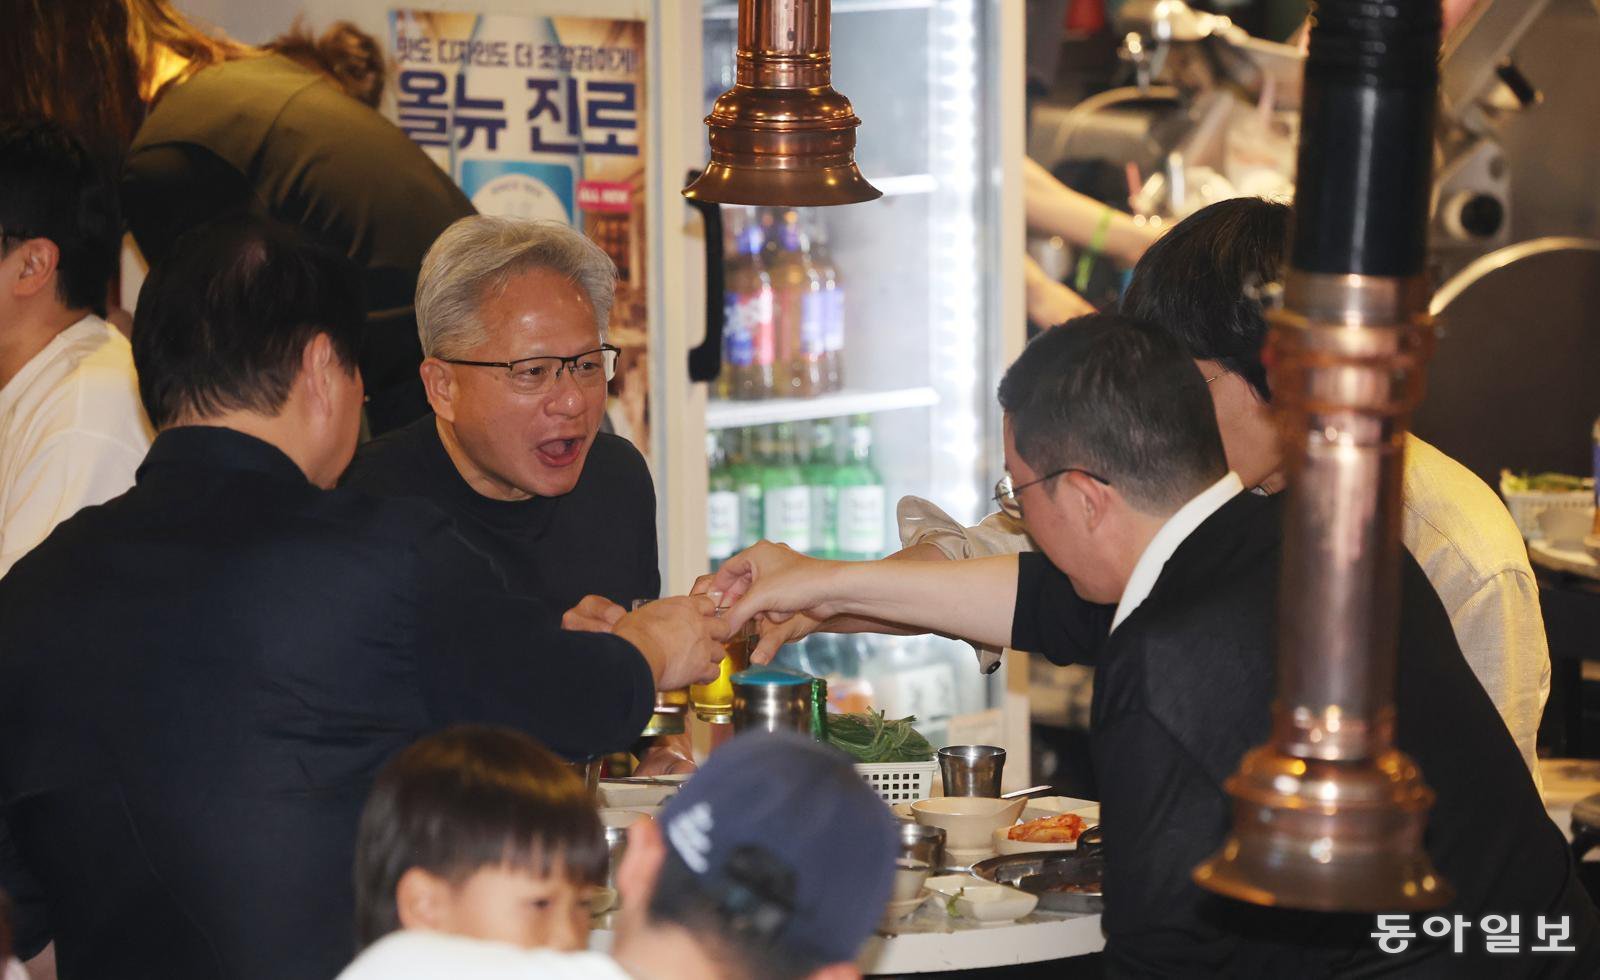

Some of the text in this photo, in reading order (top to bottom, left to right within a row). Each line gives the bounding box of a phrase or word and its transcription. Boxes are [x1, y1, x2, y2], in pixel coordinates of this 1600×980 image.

[438, 39, 508, 67] 디자인도
[514, 43, 533, 69] 더
[397, 70, 639, 156] 올뉴 진로
